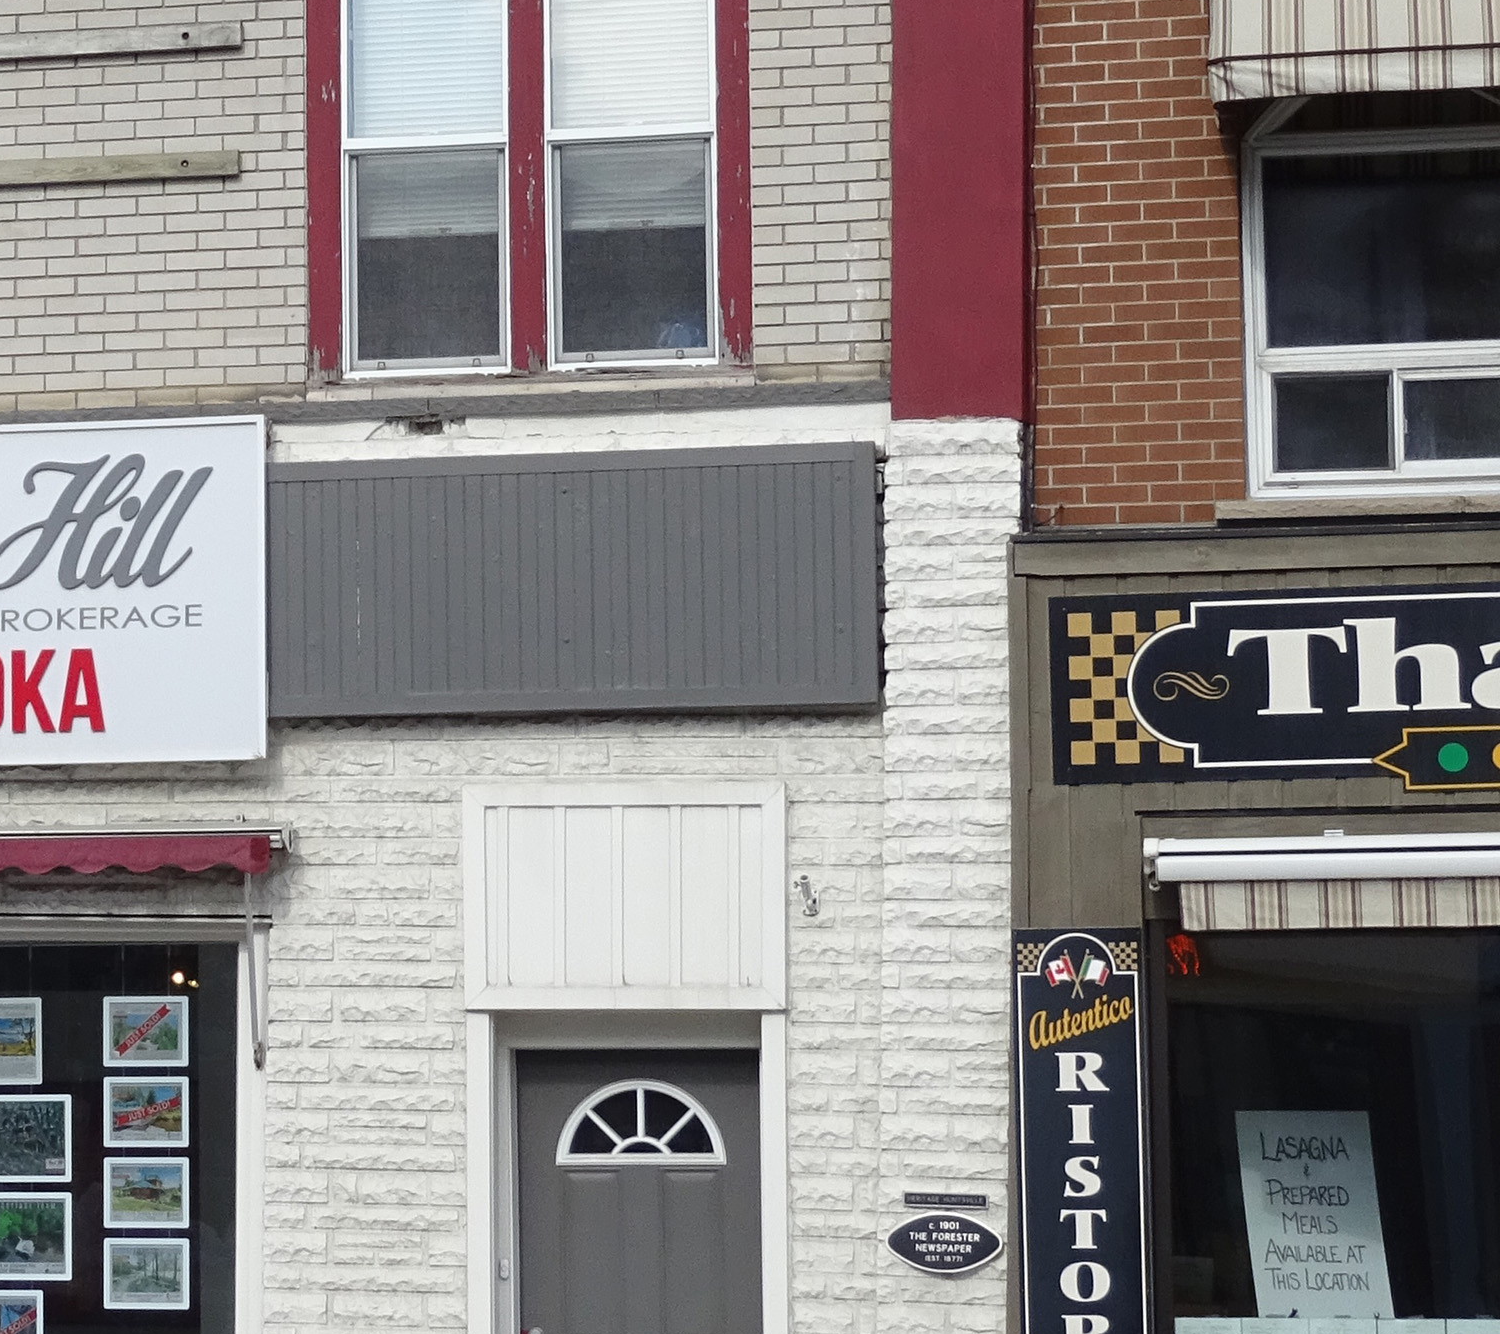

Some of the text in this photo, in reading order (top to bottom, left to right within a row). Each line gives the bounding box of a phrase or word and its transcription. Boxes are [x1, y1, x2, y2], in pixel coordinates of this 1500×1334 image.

[126, 1013, 160, 1047] JUST SOLD!
[1028, 993, 1134, 1051] Autentico
[128, 1101, 170, 1121] JUST SOLD!
[1260, 1132, 1350, 1162] LASAGNA
[1265, 1179, 1350, 1206] PREPARED
[939, 1221, 960, 1230] 1901
[1282, 1211, 1339, 1234] MEALS
[909, 1231, 981, 1242] THE FORESTER
[915, 1243, 972, 1253] NEWSPAPER
[1265, 1238, 1366, 1264] AVAILABLE AT
[1264, 1267, 1370, 1291] THIS LOCATION
[8, 1315, 31, 1334] SOLD!
